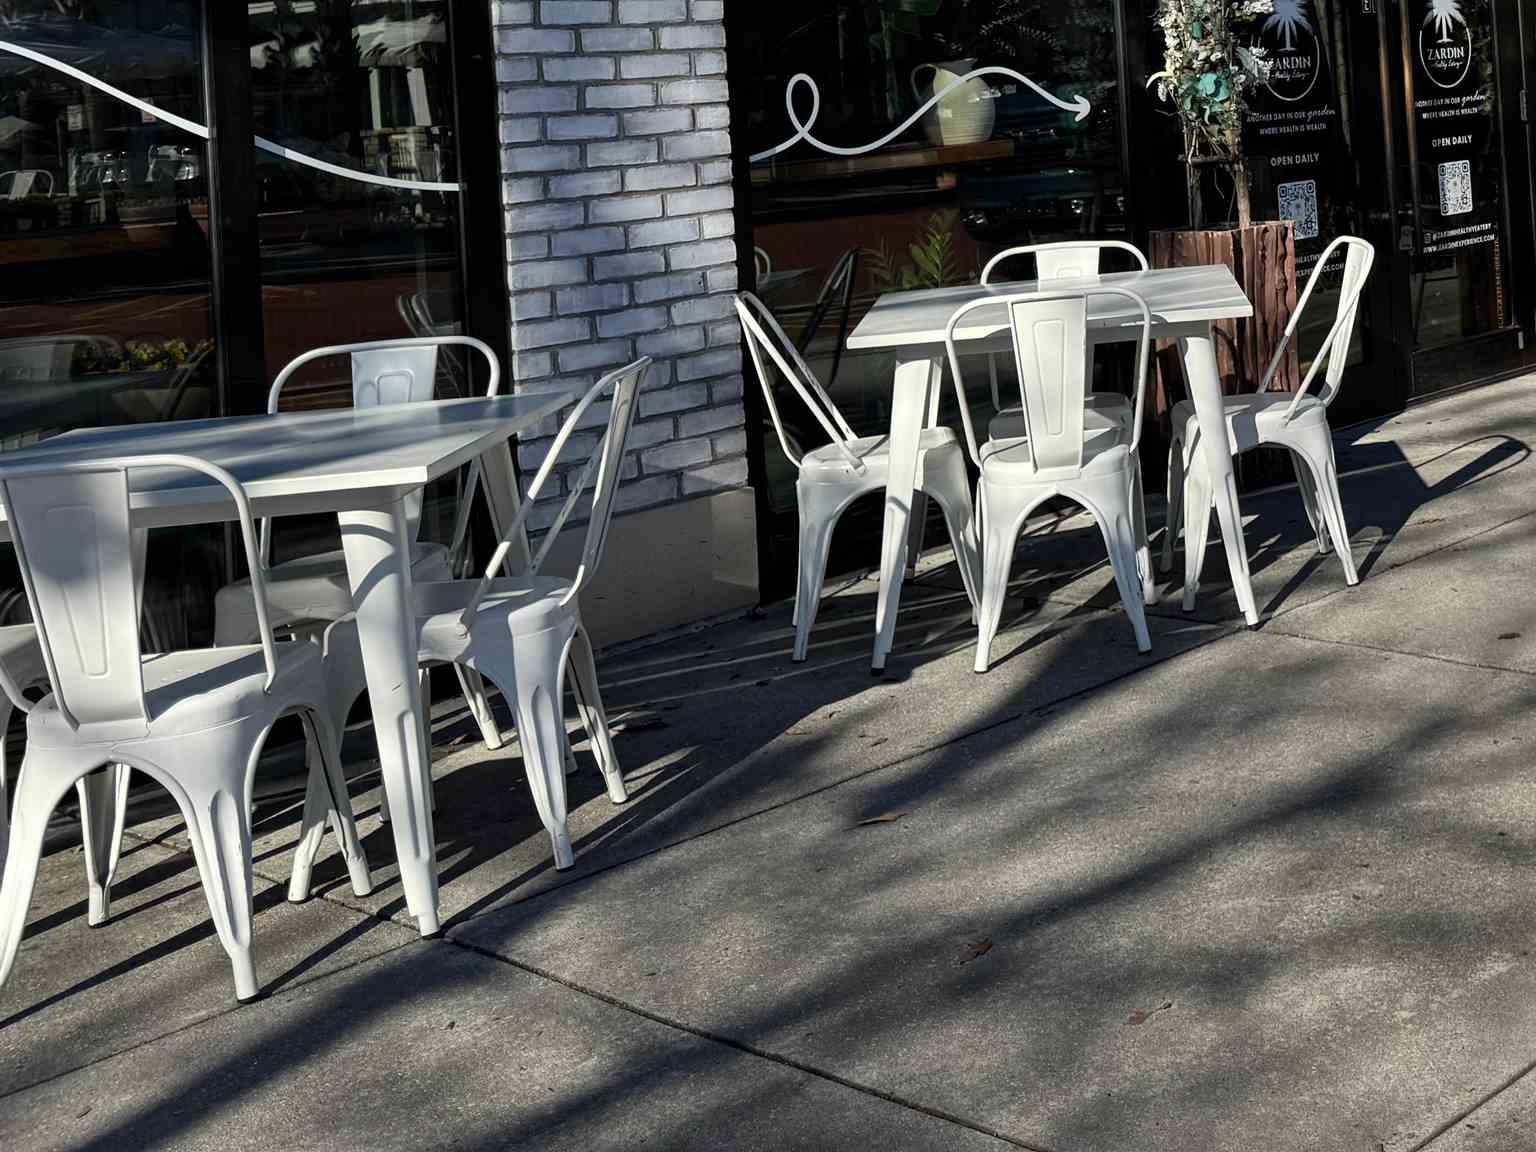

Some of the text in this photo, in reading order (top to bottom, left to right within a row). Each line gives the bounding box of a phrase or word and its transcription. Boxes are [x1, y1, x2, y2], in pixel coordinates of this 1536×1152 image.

[1427, 47, 1464, 60] ZARDIN
[1431, 134, 1473, 148] OPEN DAILY
[1270, 152, 1320, 167] OPEN DAILY
